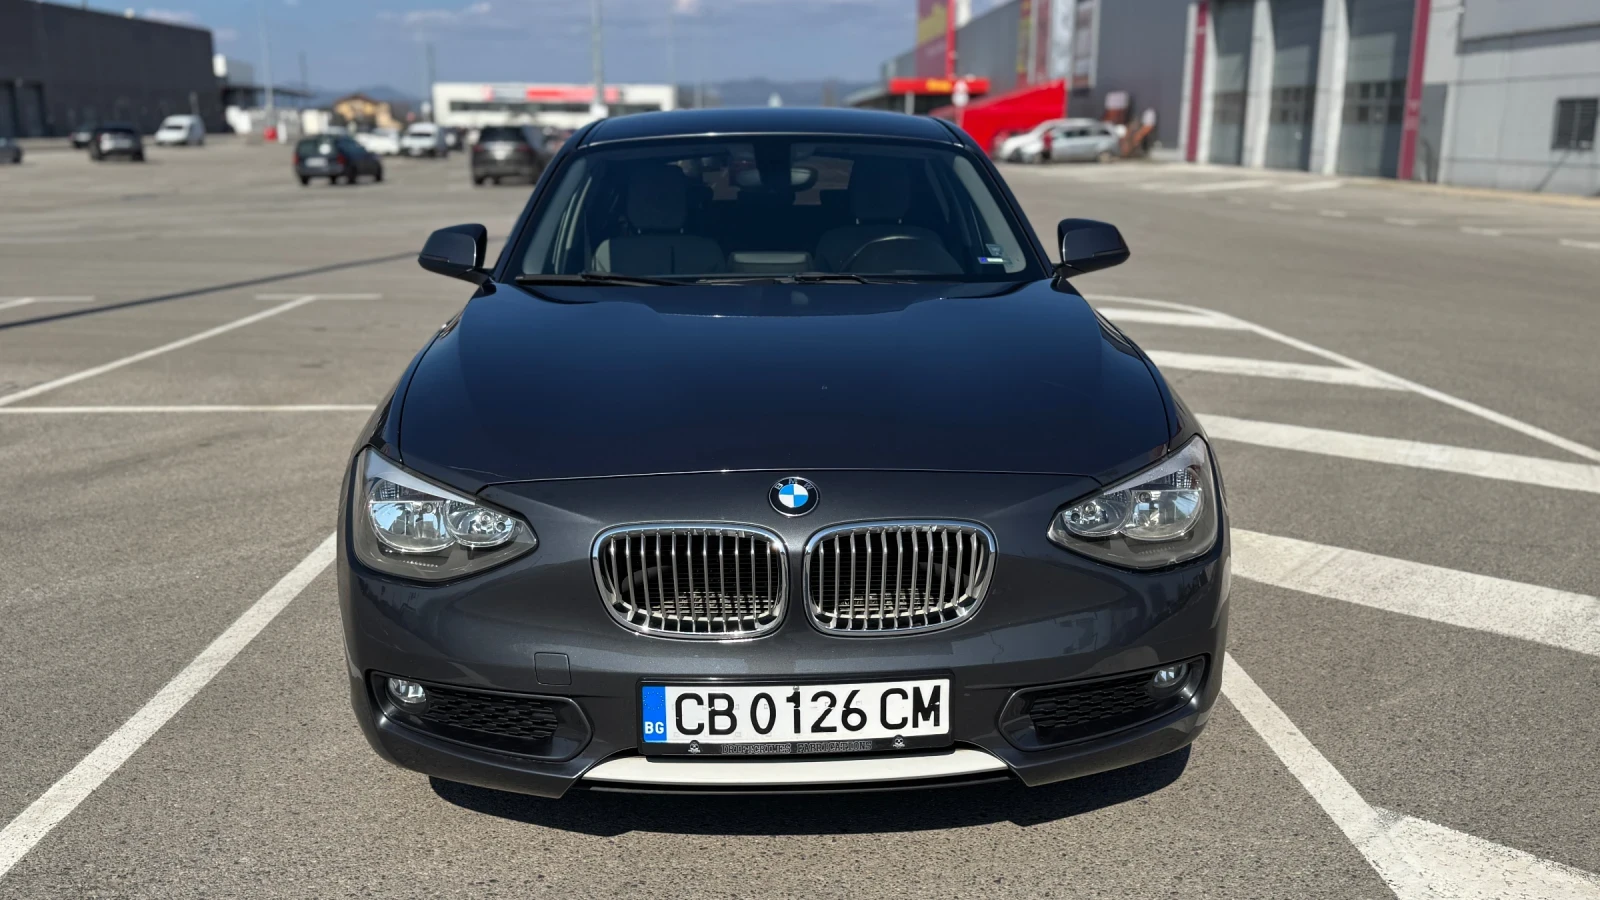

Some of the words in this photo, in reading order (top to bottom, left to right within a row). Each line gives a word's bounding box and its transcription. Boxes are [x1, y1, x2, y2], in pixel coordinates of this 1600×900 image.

[675, 692, 738, 735] CB
[750, 689, 867, 735] 0126
[880, 685, 940, 730] CM
[644, 721, 665, 735] BG
[796, 741, 872, 753] FABRICATIONS
